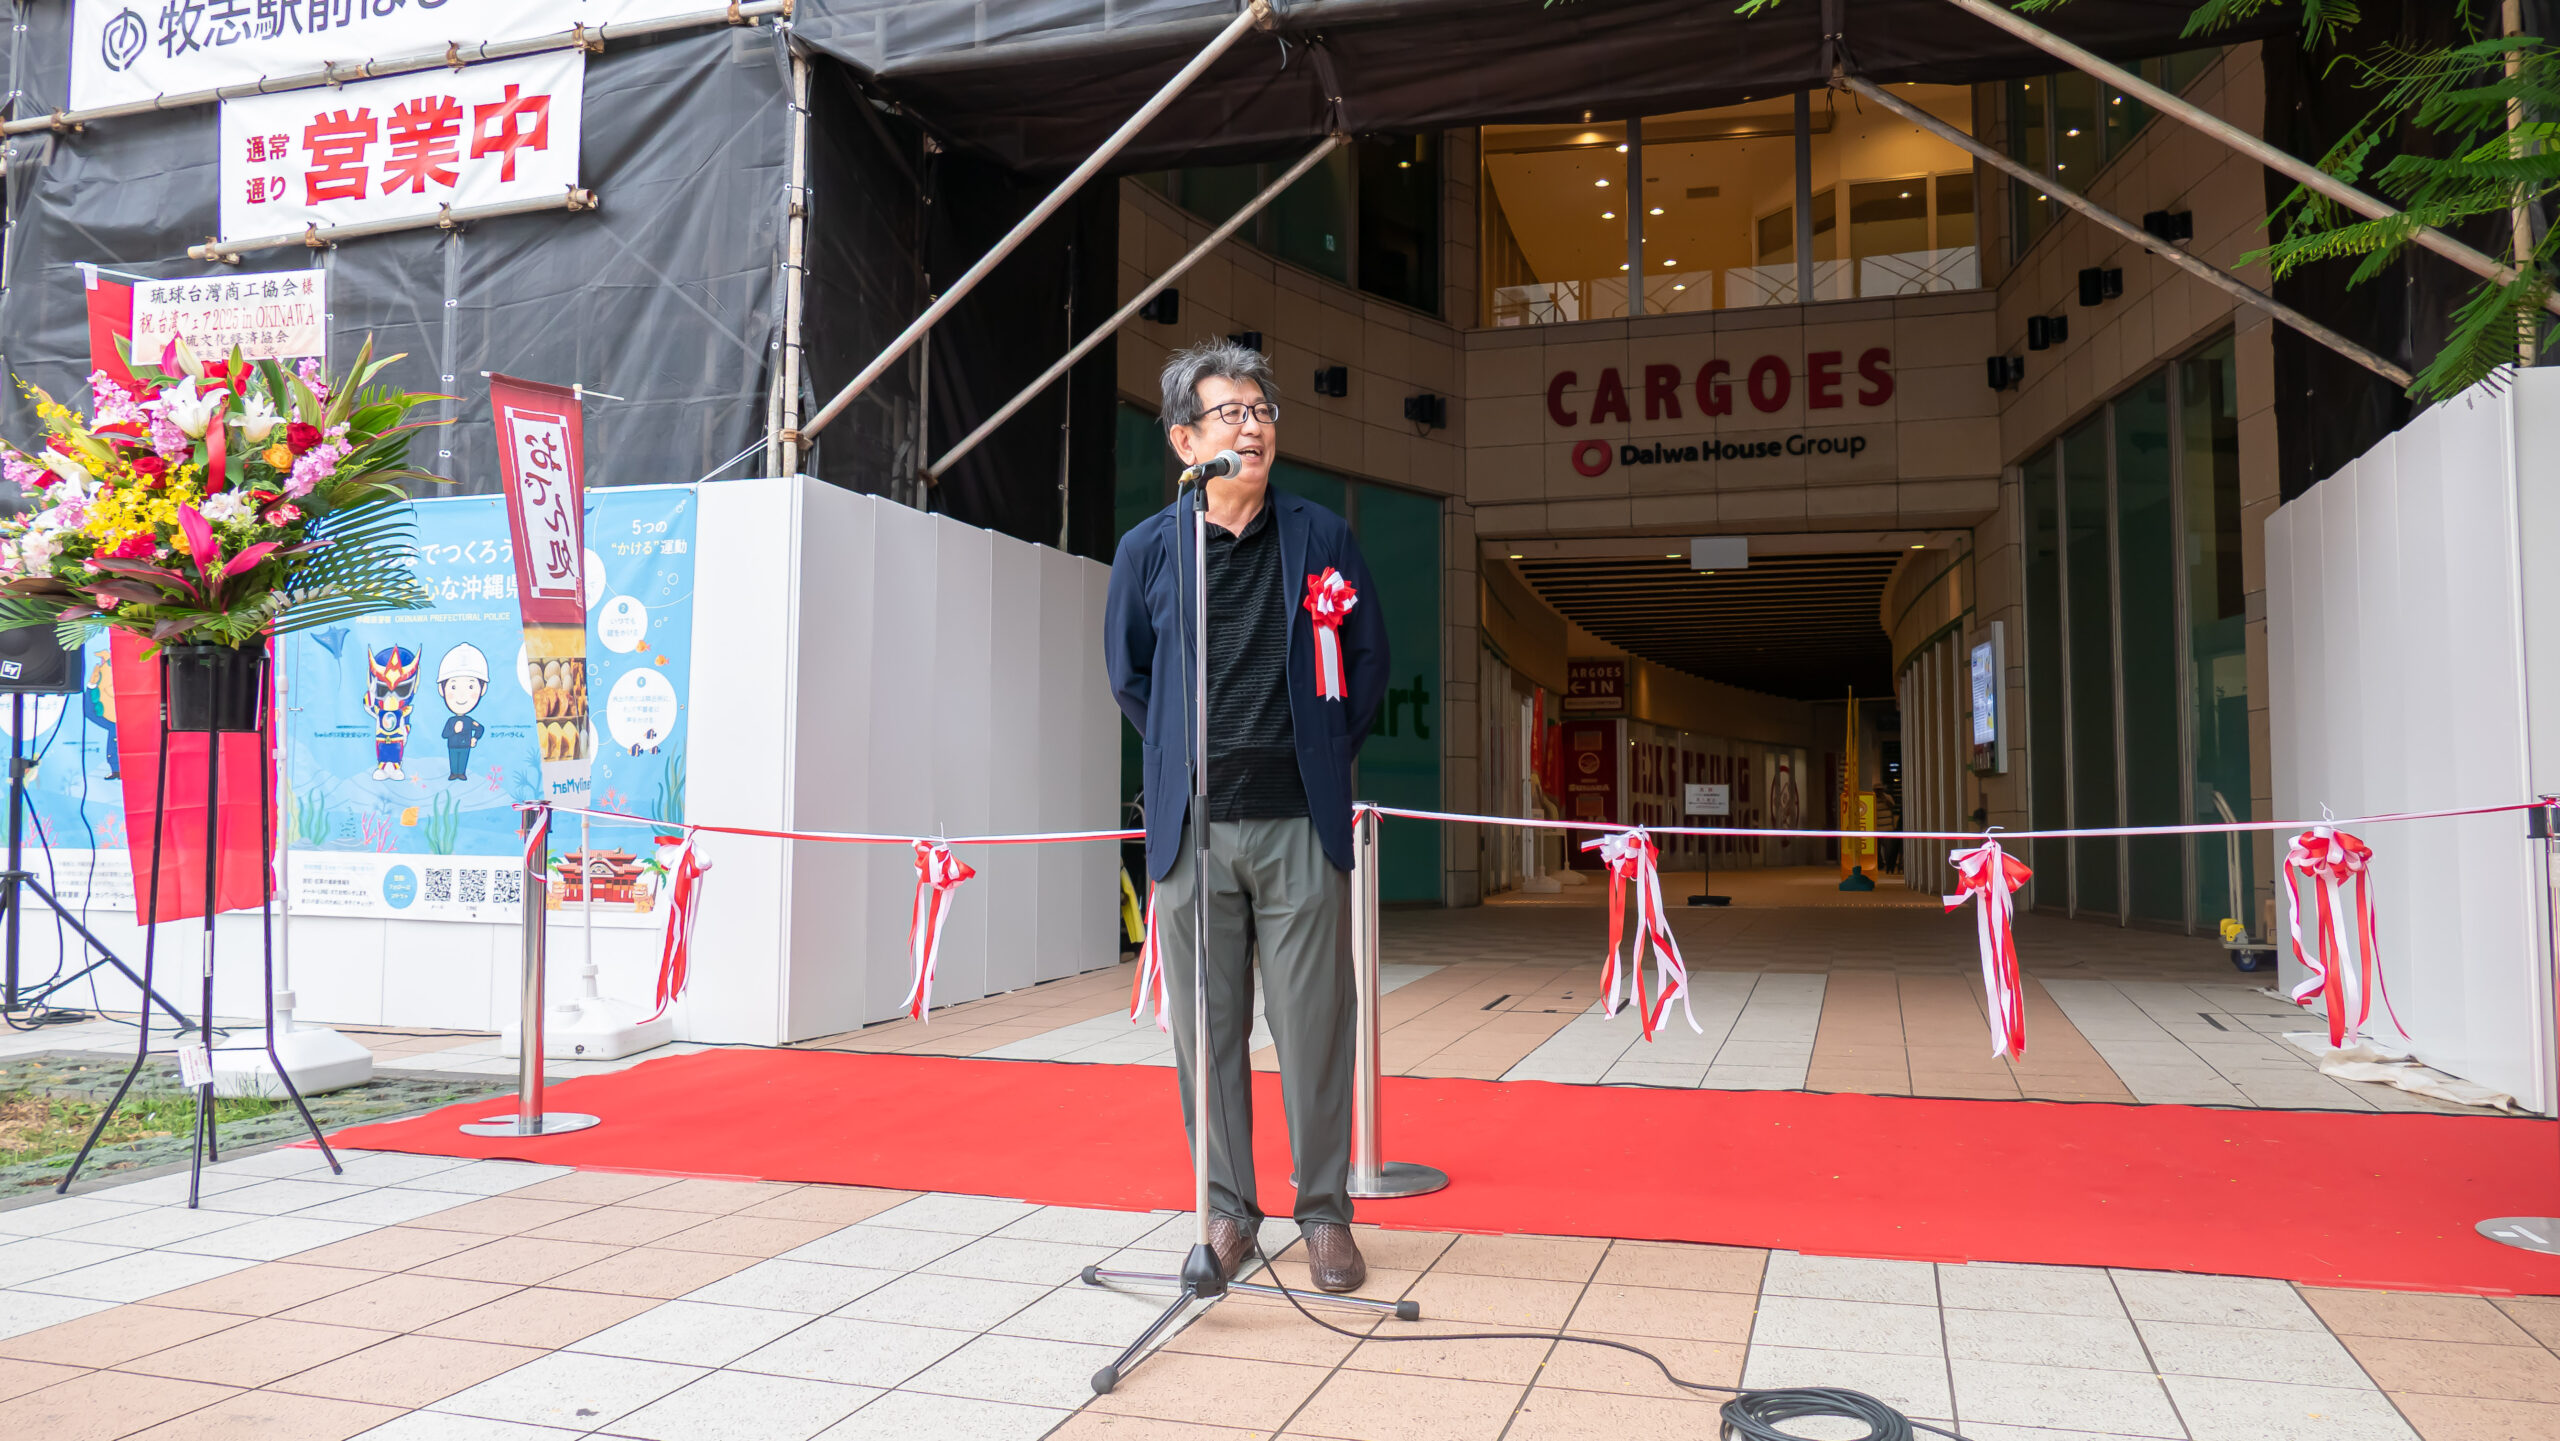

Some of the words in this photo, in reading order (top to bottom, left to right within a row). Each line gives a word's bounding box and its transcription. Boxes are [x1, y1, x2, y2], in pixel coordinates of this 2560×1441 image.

[246, 133, 290, 164] 通常
[302, 84, 551, 207] 営業中
[246, 176, 287, 205] 通り
[255, 303, 315, 329] OKINAWA
[1547, 347, 1895, 427] CARGOES
[1620, 443, 1699, 466] Daiwa
[1702, 440, 1782, 462] House
[1786, 434, 1867, 459] Group
[632, 519, 668, 536] 5つの
[395, 614, 428, 623] OKINAWA
[430, 612, 482, 622] PREFECTURAL
[483, 611, 511, 621] POLICE
[1571, 667, 1622, 678] ARGOES
[1590, 680, 1615, 694] IN
